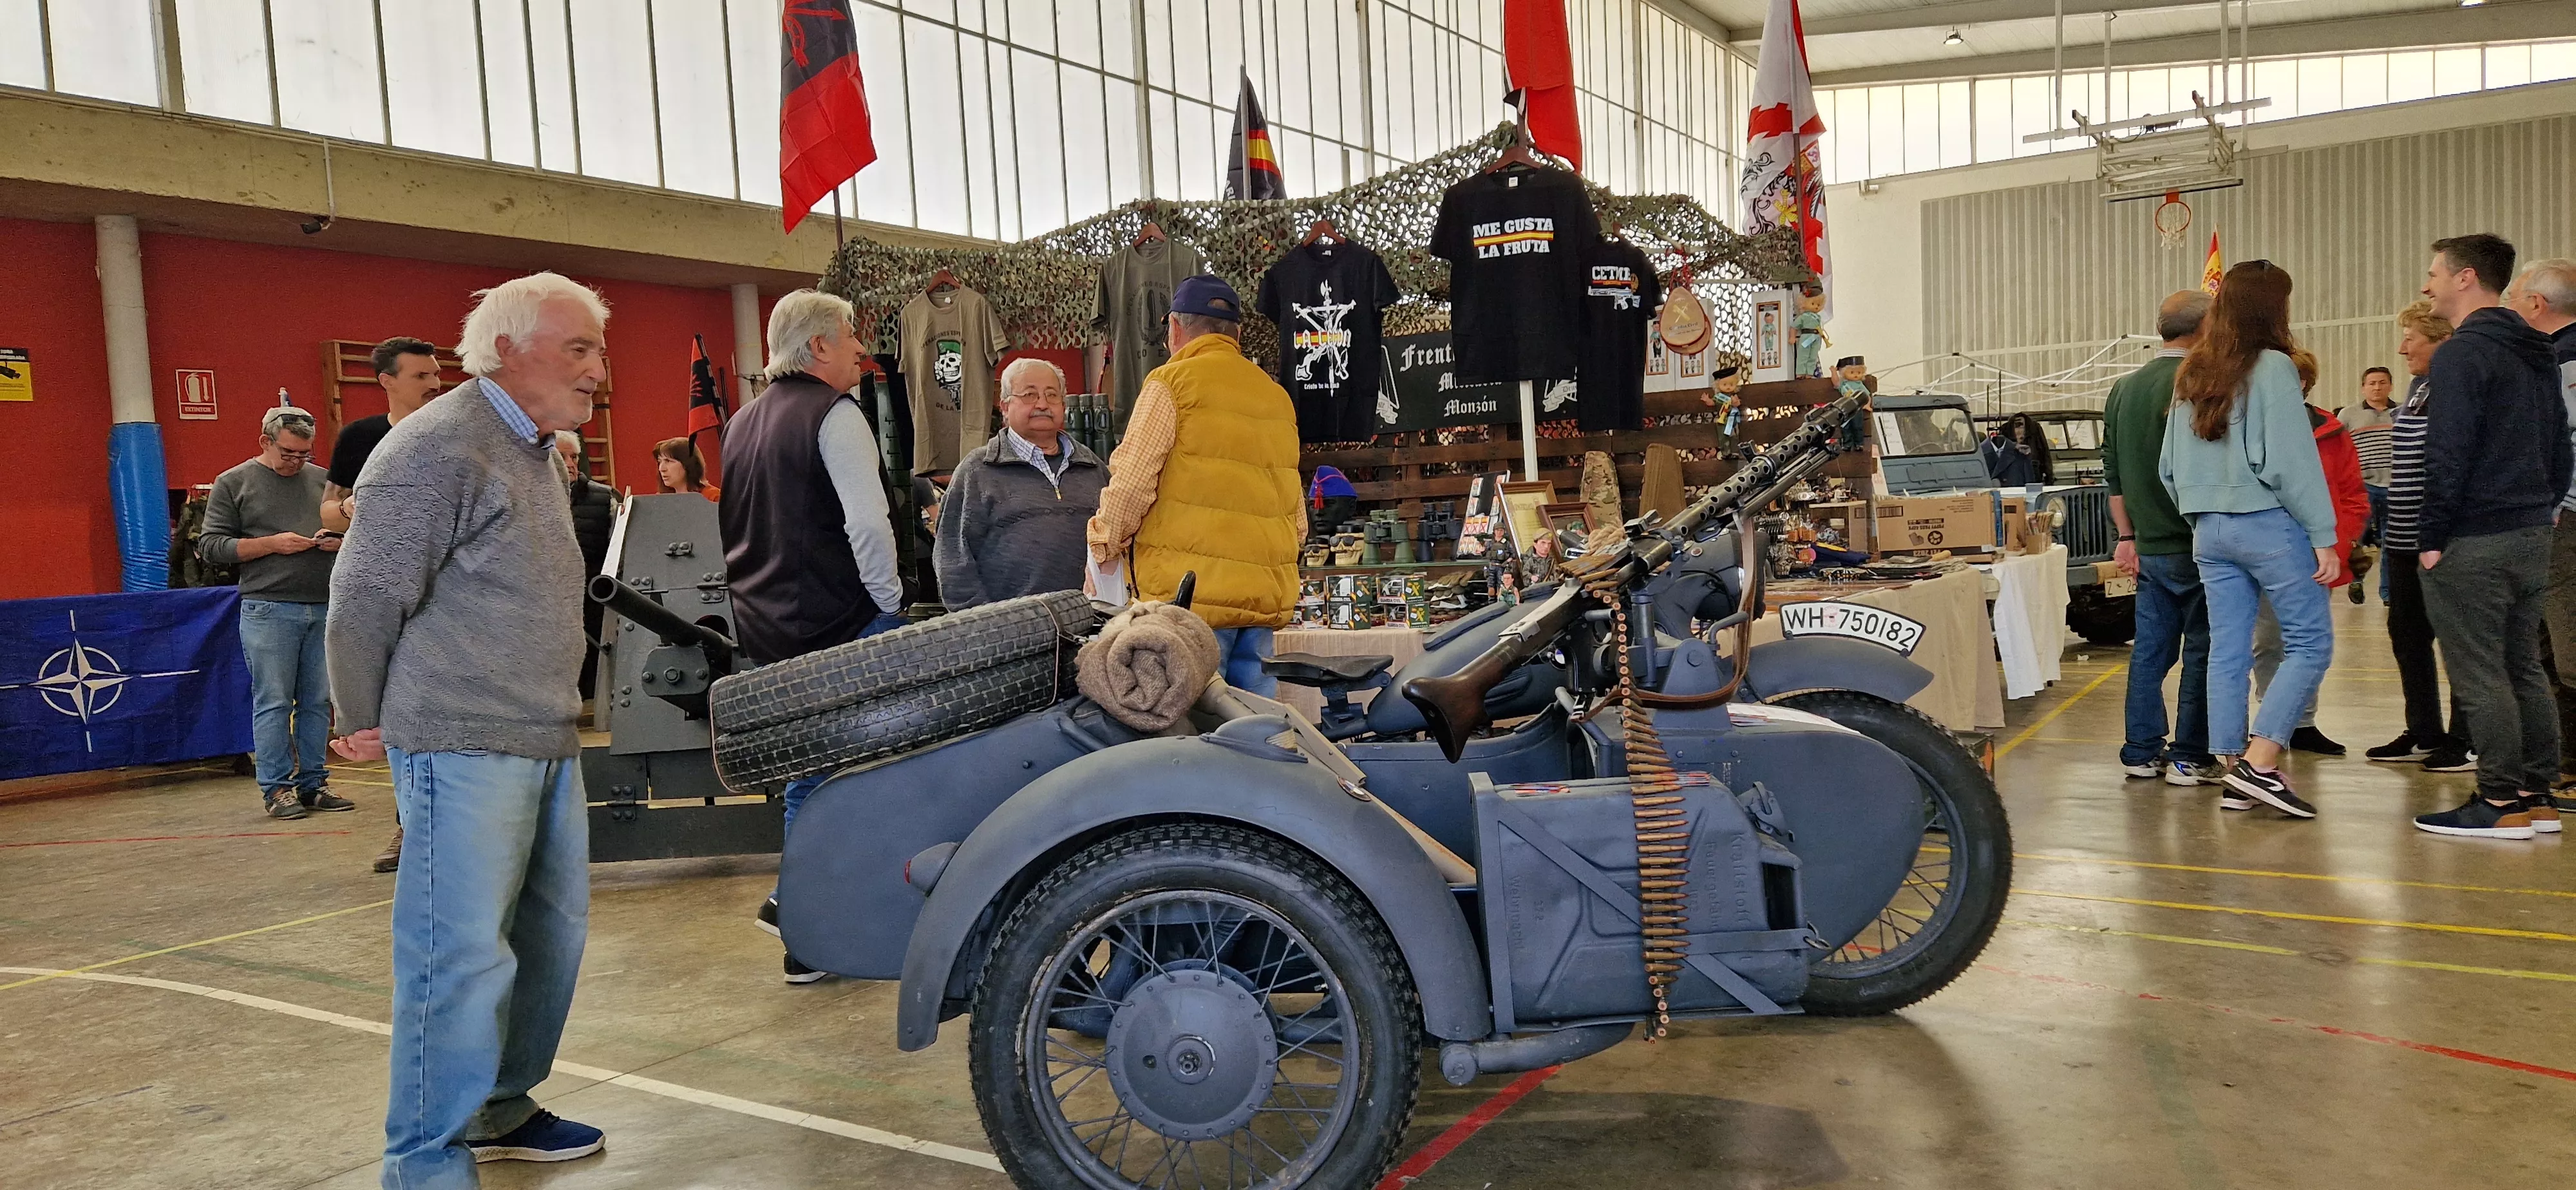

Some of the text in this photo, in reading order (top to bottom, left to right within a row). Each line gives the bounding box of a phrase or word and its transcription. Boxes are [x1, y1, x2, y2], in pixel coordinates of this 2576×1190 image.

[1473, 217, 1554, 238] ME GUSTA
[1478, 240, 1550, 259] LA FRUTA
[1592, 265, 1631, 281] CETME
[1400, 343, 1455, 372] Frent
[1443, 395, 1497, 417] Monzón
[1730, 832, 1751, 922] Kraftstoff
